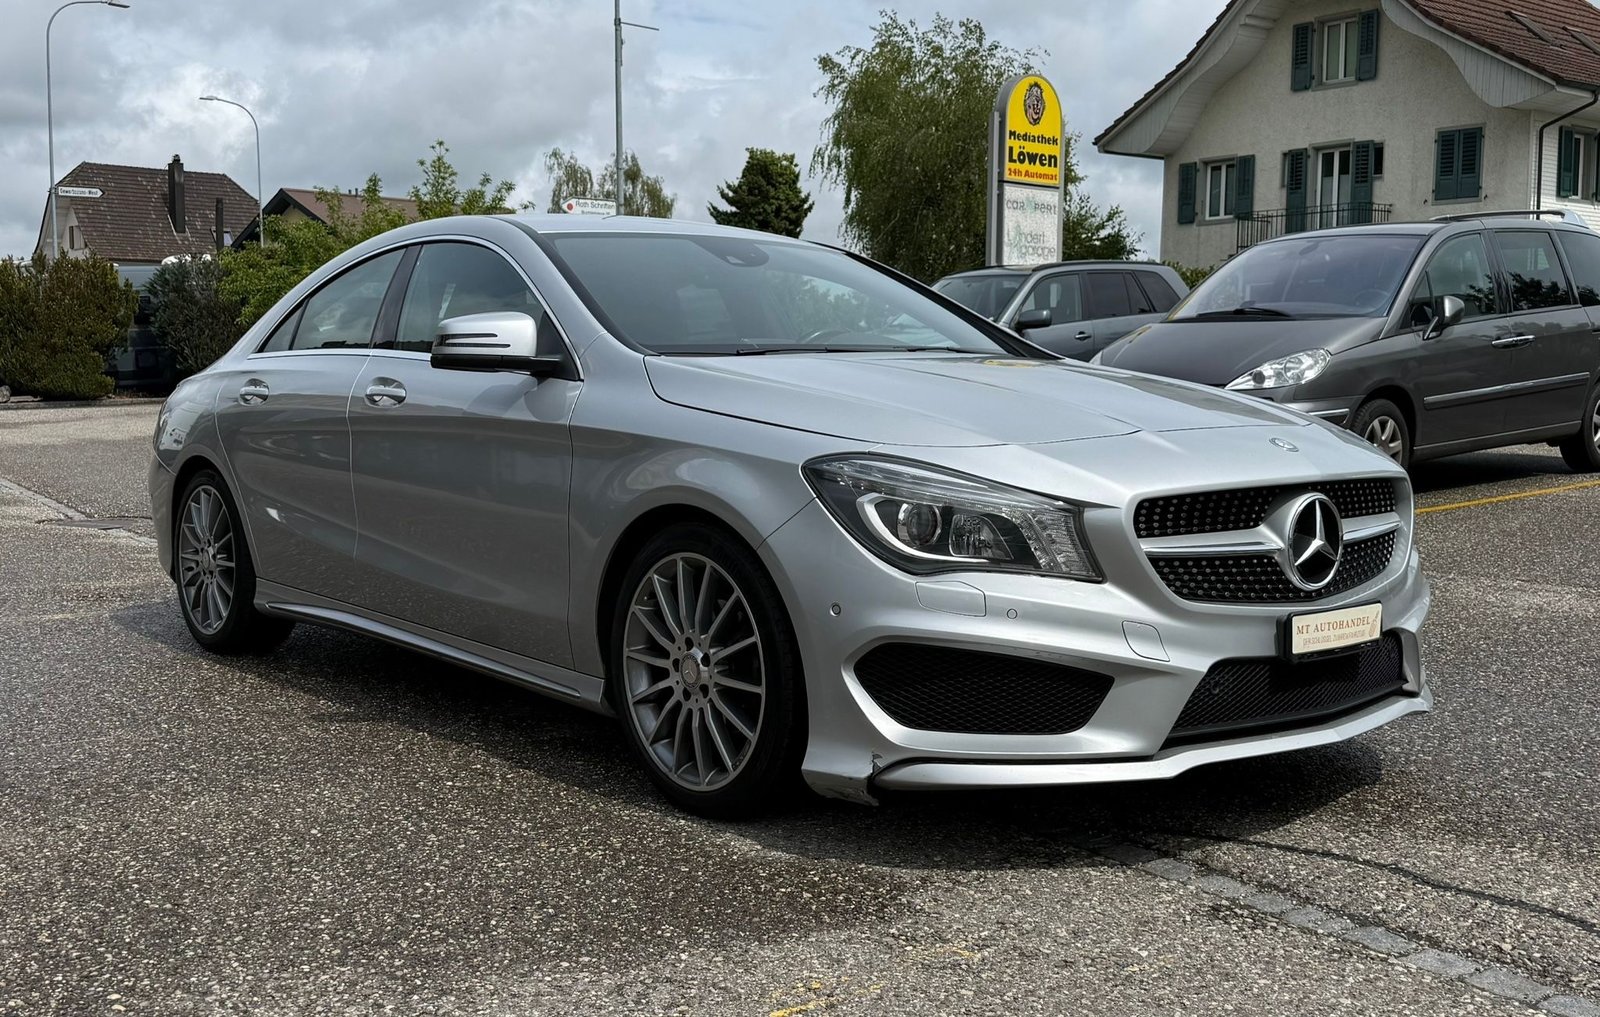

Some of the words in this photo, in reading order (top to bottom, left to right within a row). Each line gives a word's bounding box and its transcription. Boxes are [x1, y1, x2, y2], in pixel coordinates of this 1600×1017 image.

[1009, 130, 1058, 146] Mediathek
[1008, 145, 1058, 168] Löwen
[1008, 168, 1022, 178] 24h
[1024, 170, 1058, 181] Automat
[576, 200, 590, 208] Roth
[1296, 624, 1311, 635] MT
[1313, 616, 1371, 633] AUTOHANDEL
